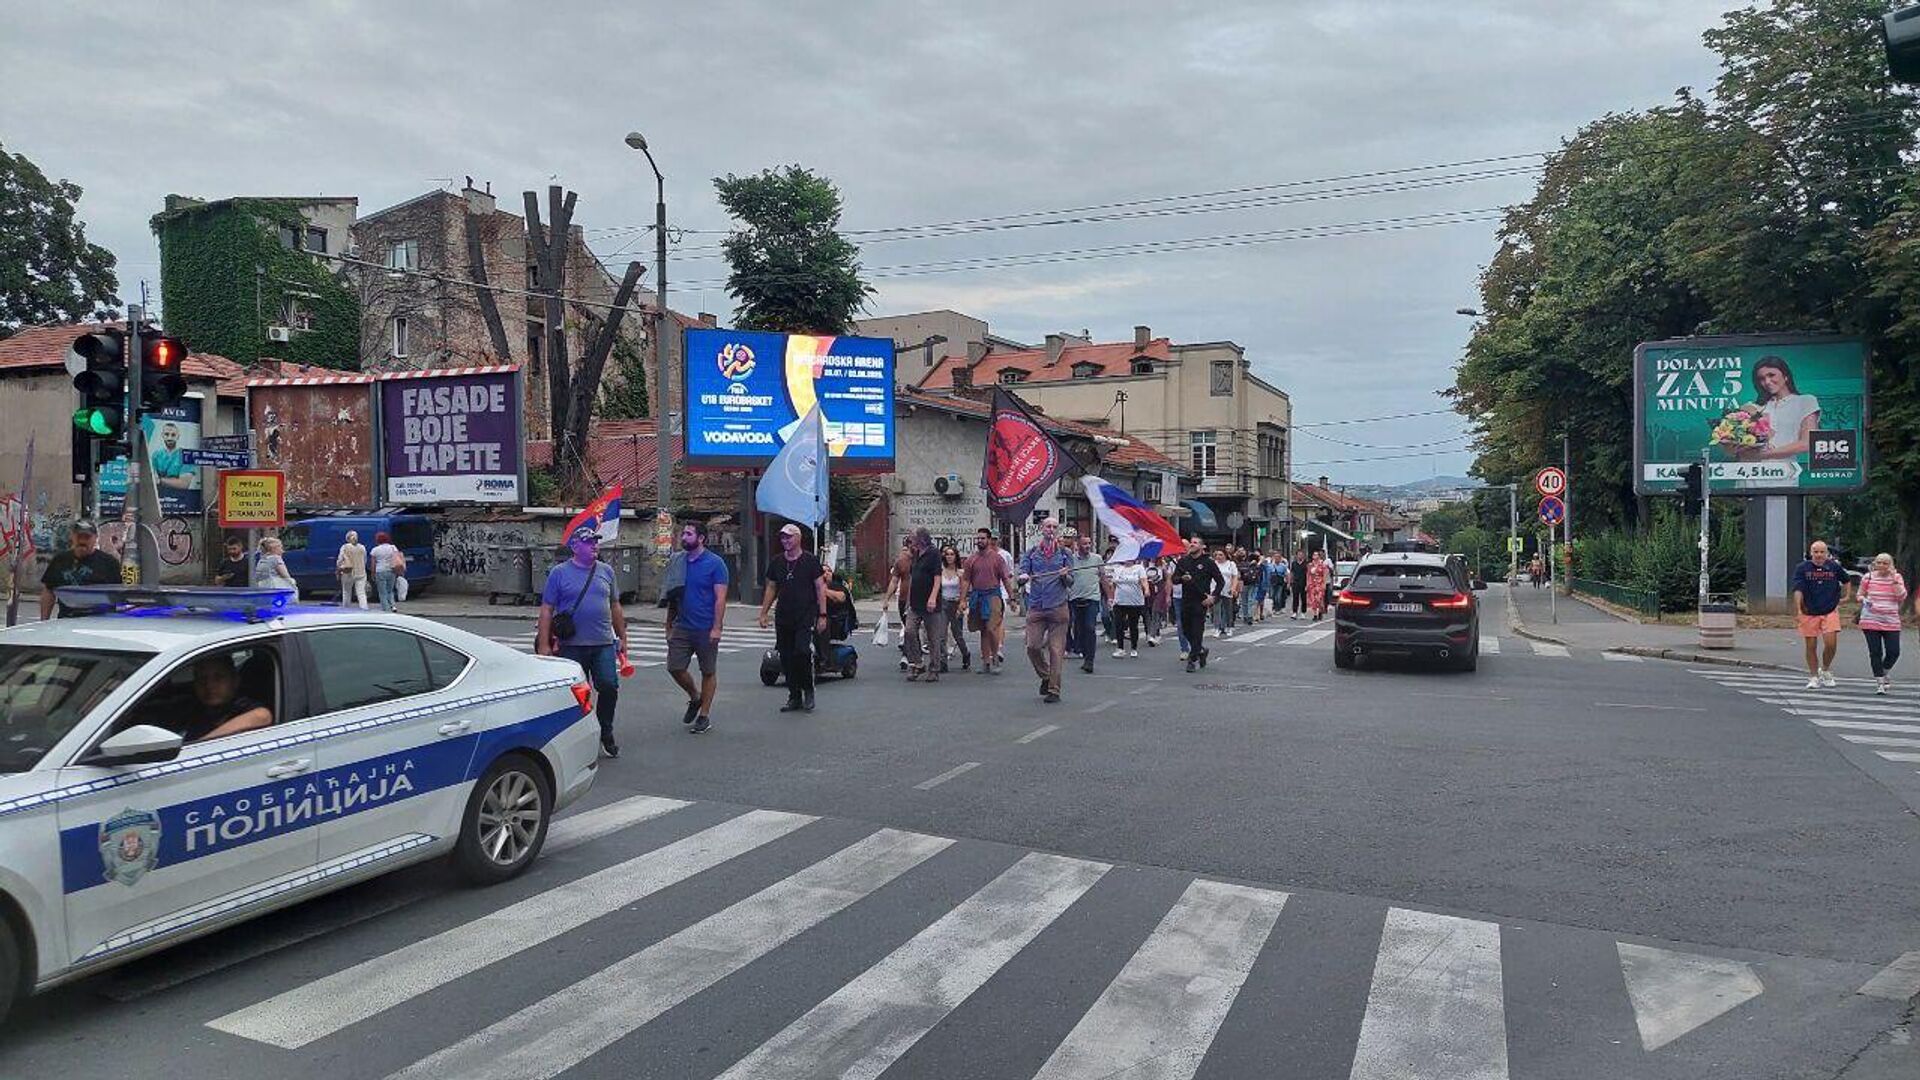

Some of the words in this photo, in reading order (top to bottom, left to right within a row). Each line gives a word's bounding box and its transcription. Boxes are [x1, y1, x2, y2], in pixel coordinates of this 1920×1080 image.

[1656, 356, 1742, 371] DOLAZIM
[1656, 371, 1710, 397] ZA
[1721, 370, 1743, 396] 5
[402, 384, 505, 416] FASADE
[718, 395, 773, 407] EUROBASKET
[1656, 397, 1740, 411] MINUTA
[404, 414, 468, 445] BOJE
[703, 431, 774, 444] VODAVODA
[1815, 439, 1849, 453] BIG
[403, 442, 501, 473] TAPETE
[483, 479, 514, 489] ROMA
[1542, 475, 1560, 489] 40
[185, 758, 417, 826] САОБРАЋАЈНА
[185, 772, 415, 852] ПОЛИЦИЈА
